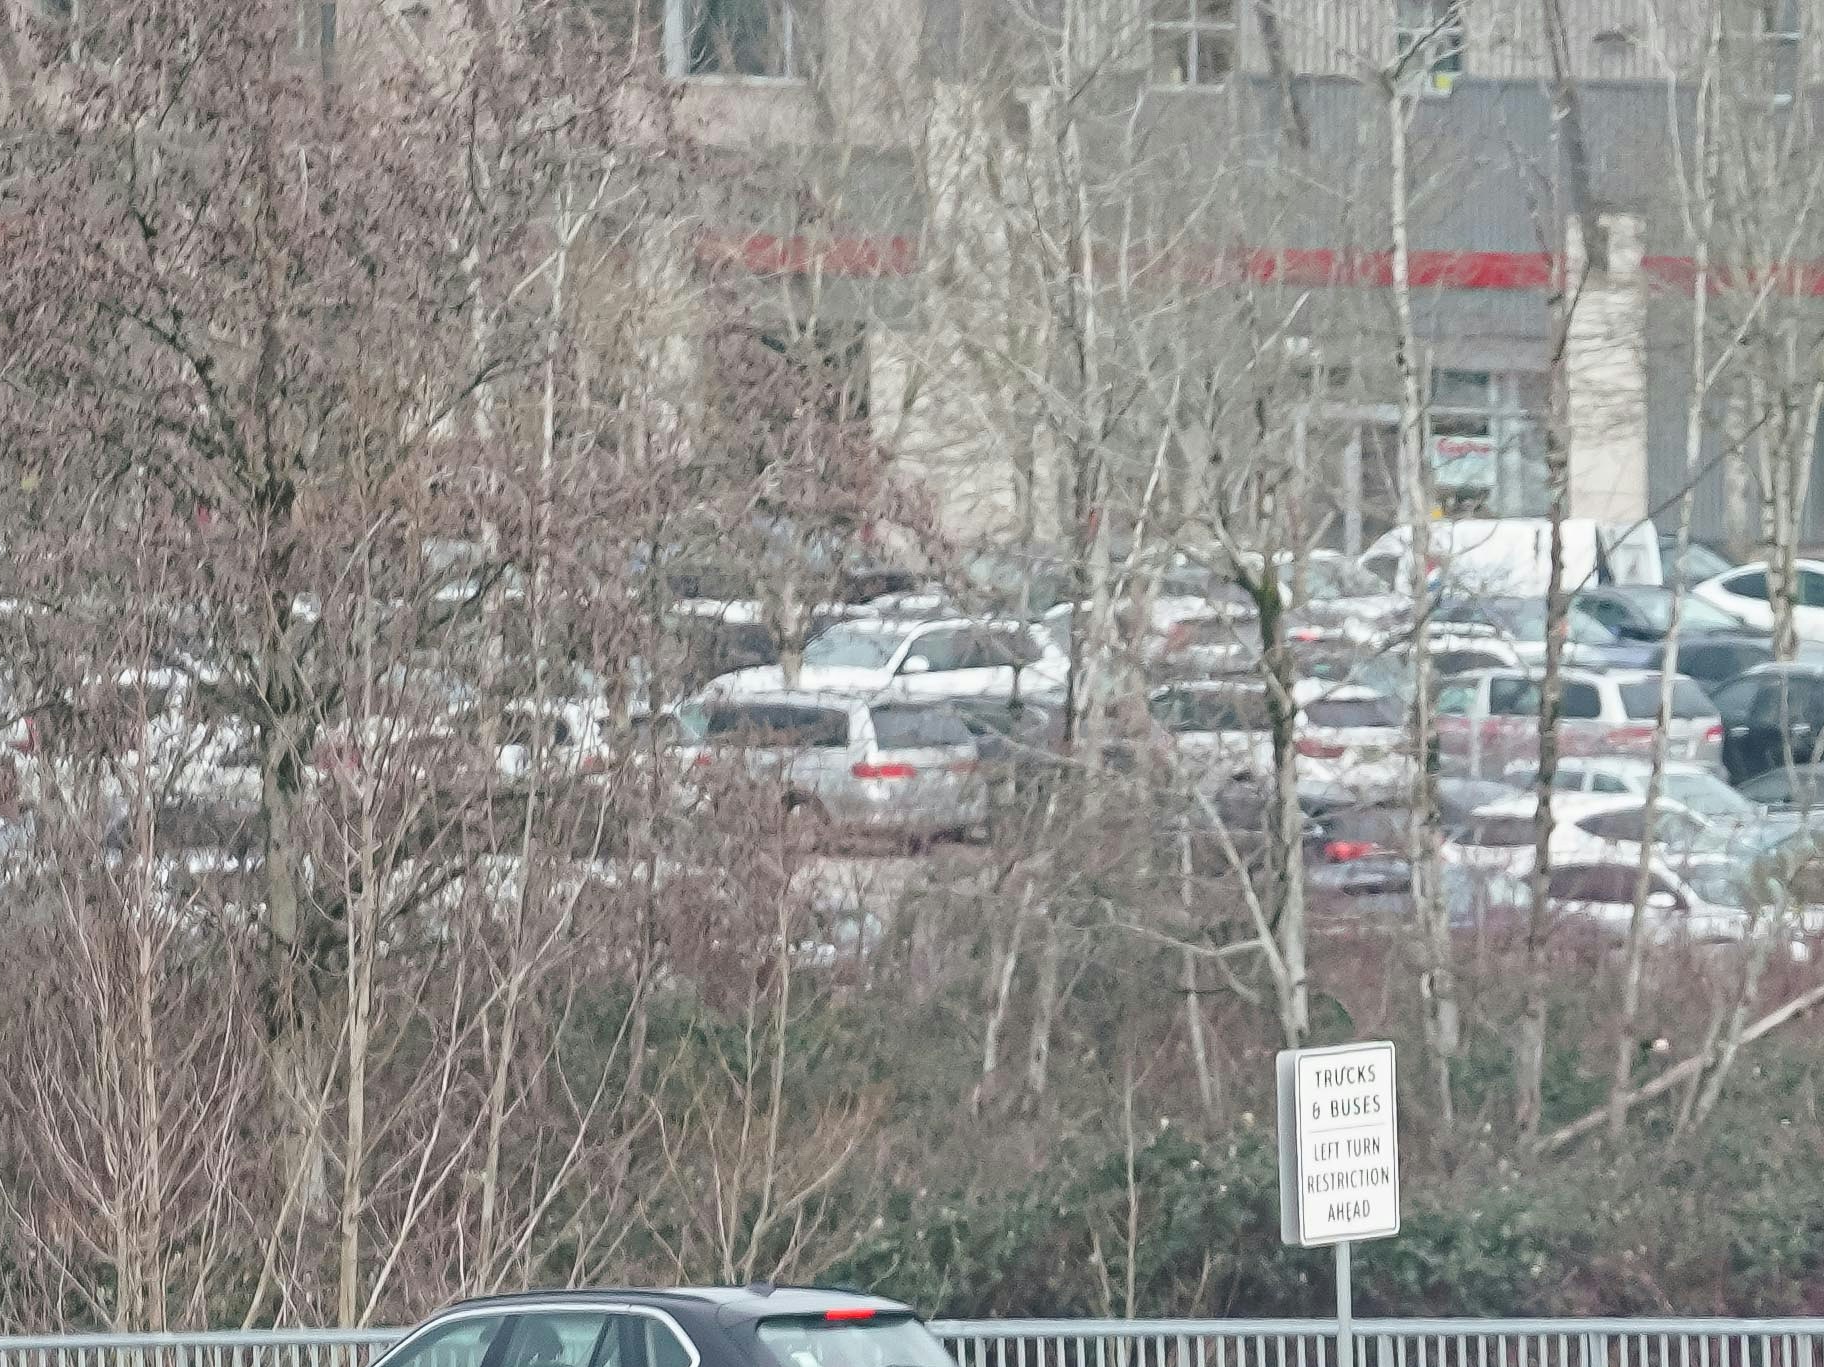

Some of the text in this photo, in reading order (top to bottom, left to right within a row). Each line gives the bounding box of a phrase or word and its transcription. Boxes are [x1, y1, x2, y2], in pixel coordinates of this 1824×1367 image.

[1315, 1064, 1377, 1089] TRUCKS
[1330, 1094, 1382, 1118] BUSES
[1313, 1136, 1382, 1162] LEFT TURN
[1306, 1165, 1390, 1194] RESTRICTION
[1327, 1198, 1371, 1223] AHEAD
